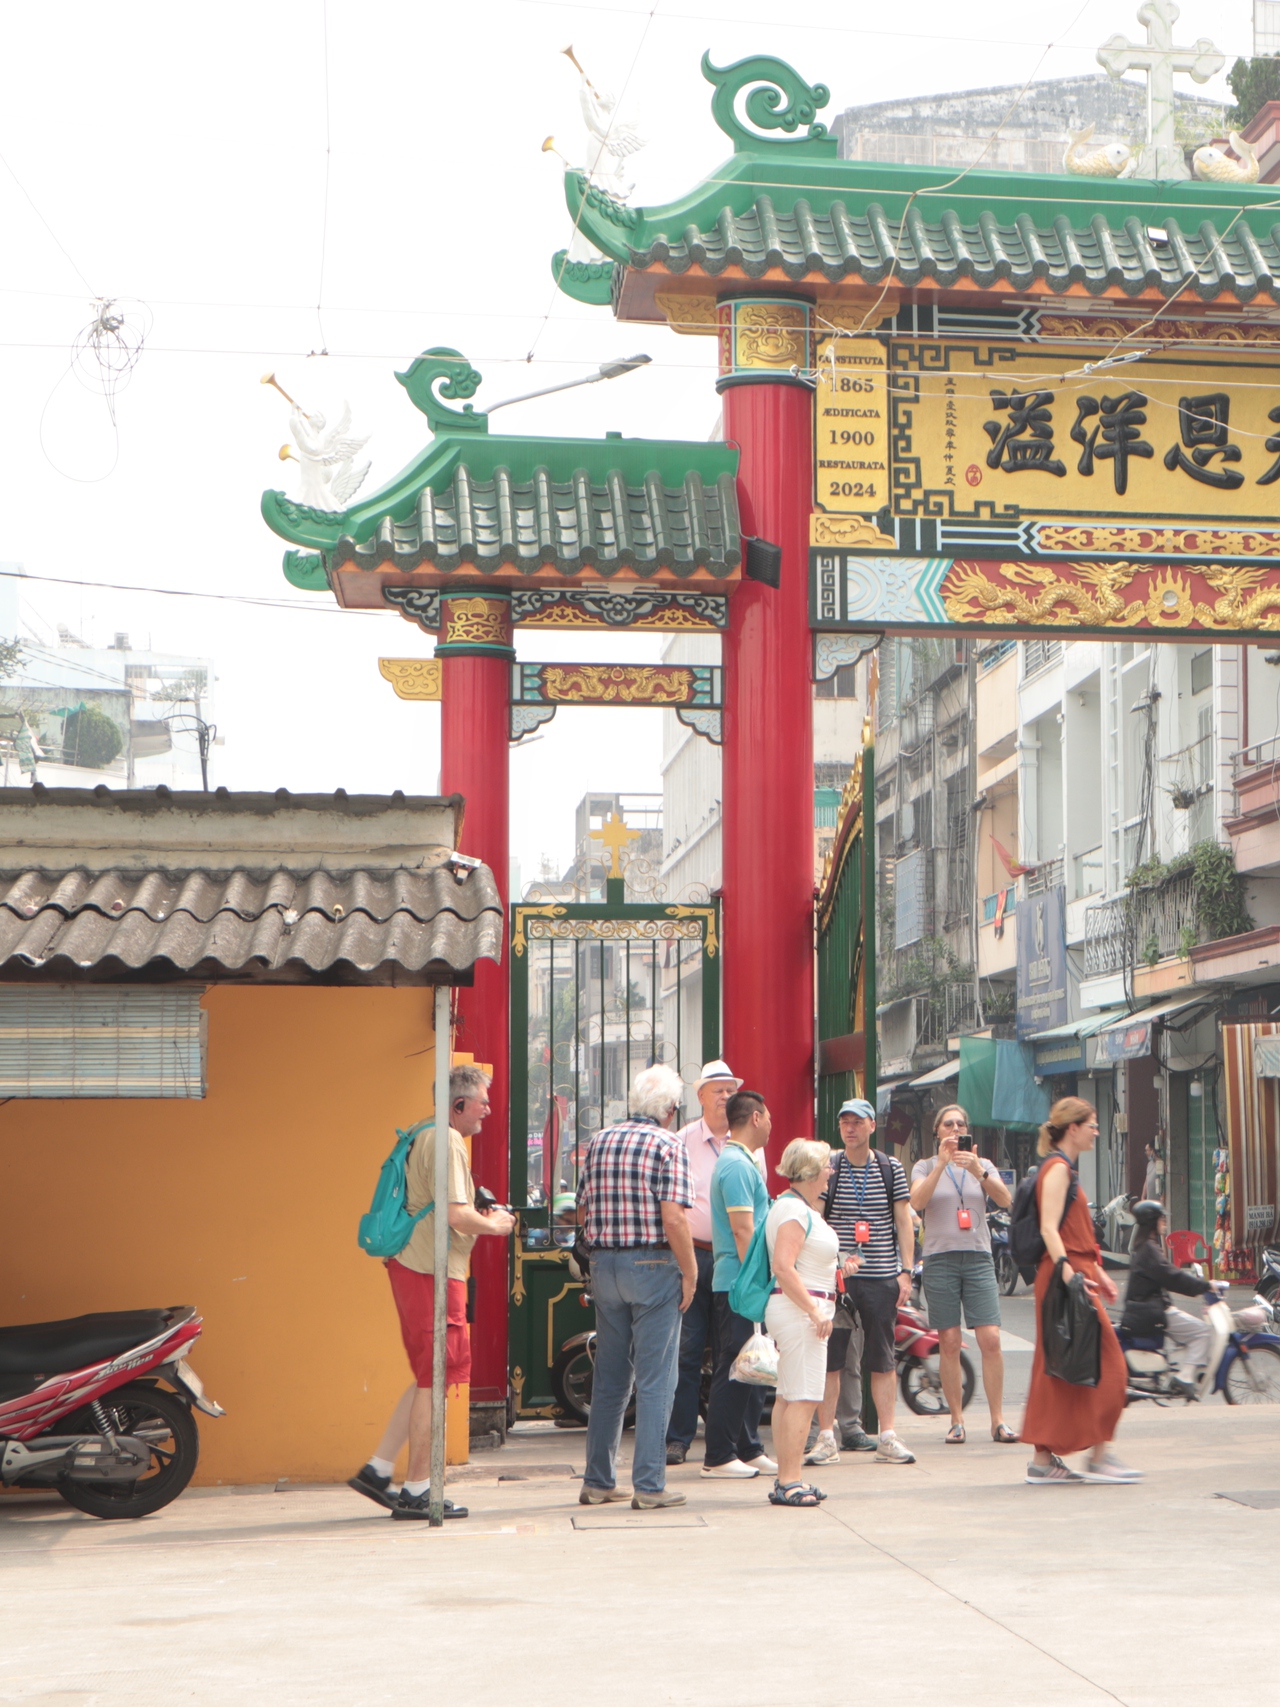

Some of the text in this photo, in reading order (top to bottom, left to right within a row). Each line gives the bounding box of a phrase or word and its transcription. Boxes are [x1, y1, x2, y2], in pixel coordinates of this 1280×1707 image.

[818, 354, 885, 366] CONSTITUTA
[829, 376, 875, 393] 1865
[822, 407, 881, 418] ÆDIFICATA
[829, 429, 875, 446] 1900
[818, 459, 886, 471] RESTAURATA
[829, 481, 877, 498] 2024
